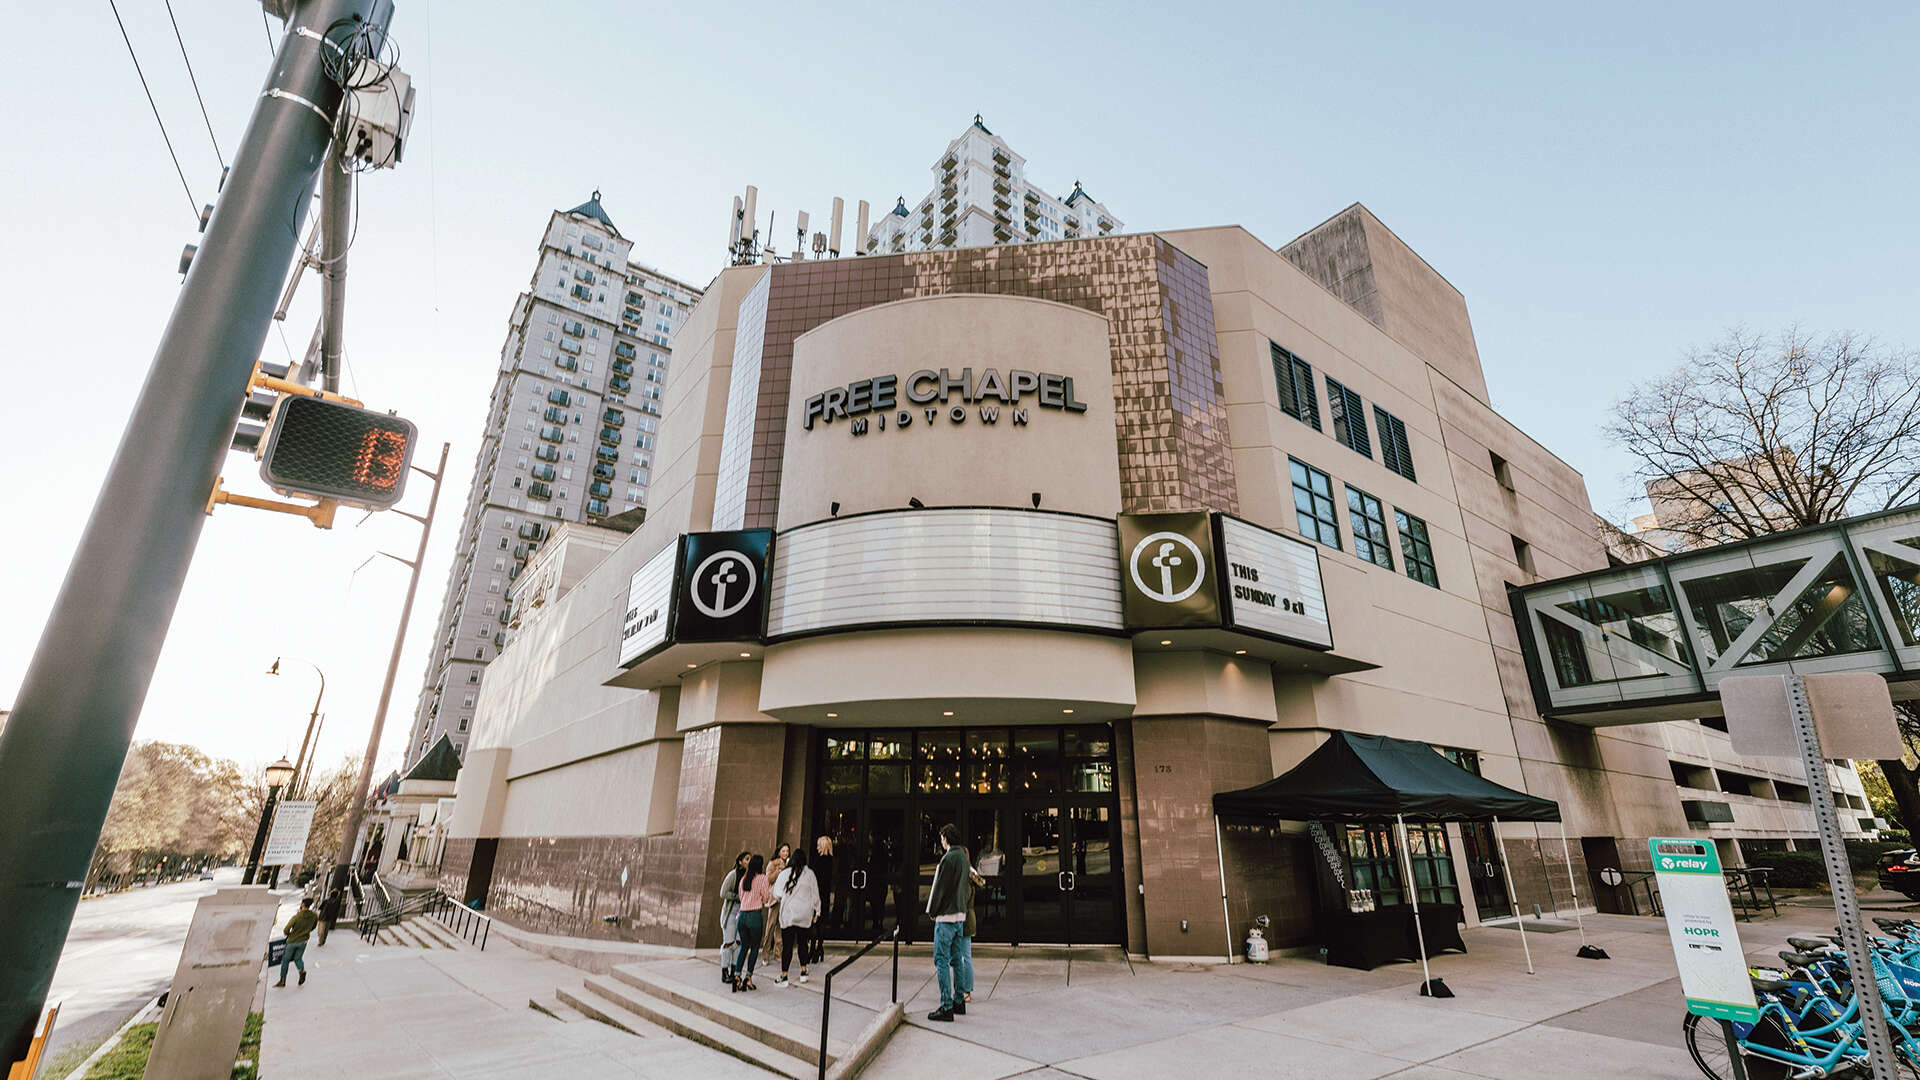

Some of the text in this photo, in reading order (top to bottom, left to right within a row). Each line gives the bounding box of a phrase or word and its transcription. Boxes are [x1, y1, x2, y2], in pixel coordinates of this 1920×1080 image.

[803, 367, 1088, 431] FREE CHAPEL
[851, 405, 1029, 436] MIDTOWN
[1231, 562, 1259, 582] THIS
[1234, 585, 1276, 607] SUNDAY
[1283, 598, 1291, 611] 9
[1676, 858, 1708, 870] relay
[1684, 926, 1720, 937] HOPR
